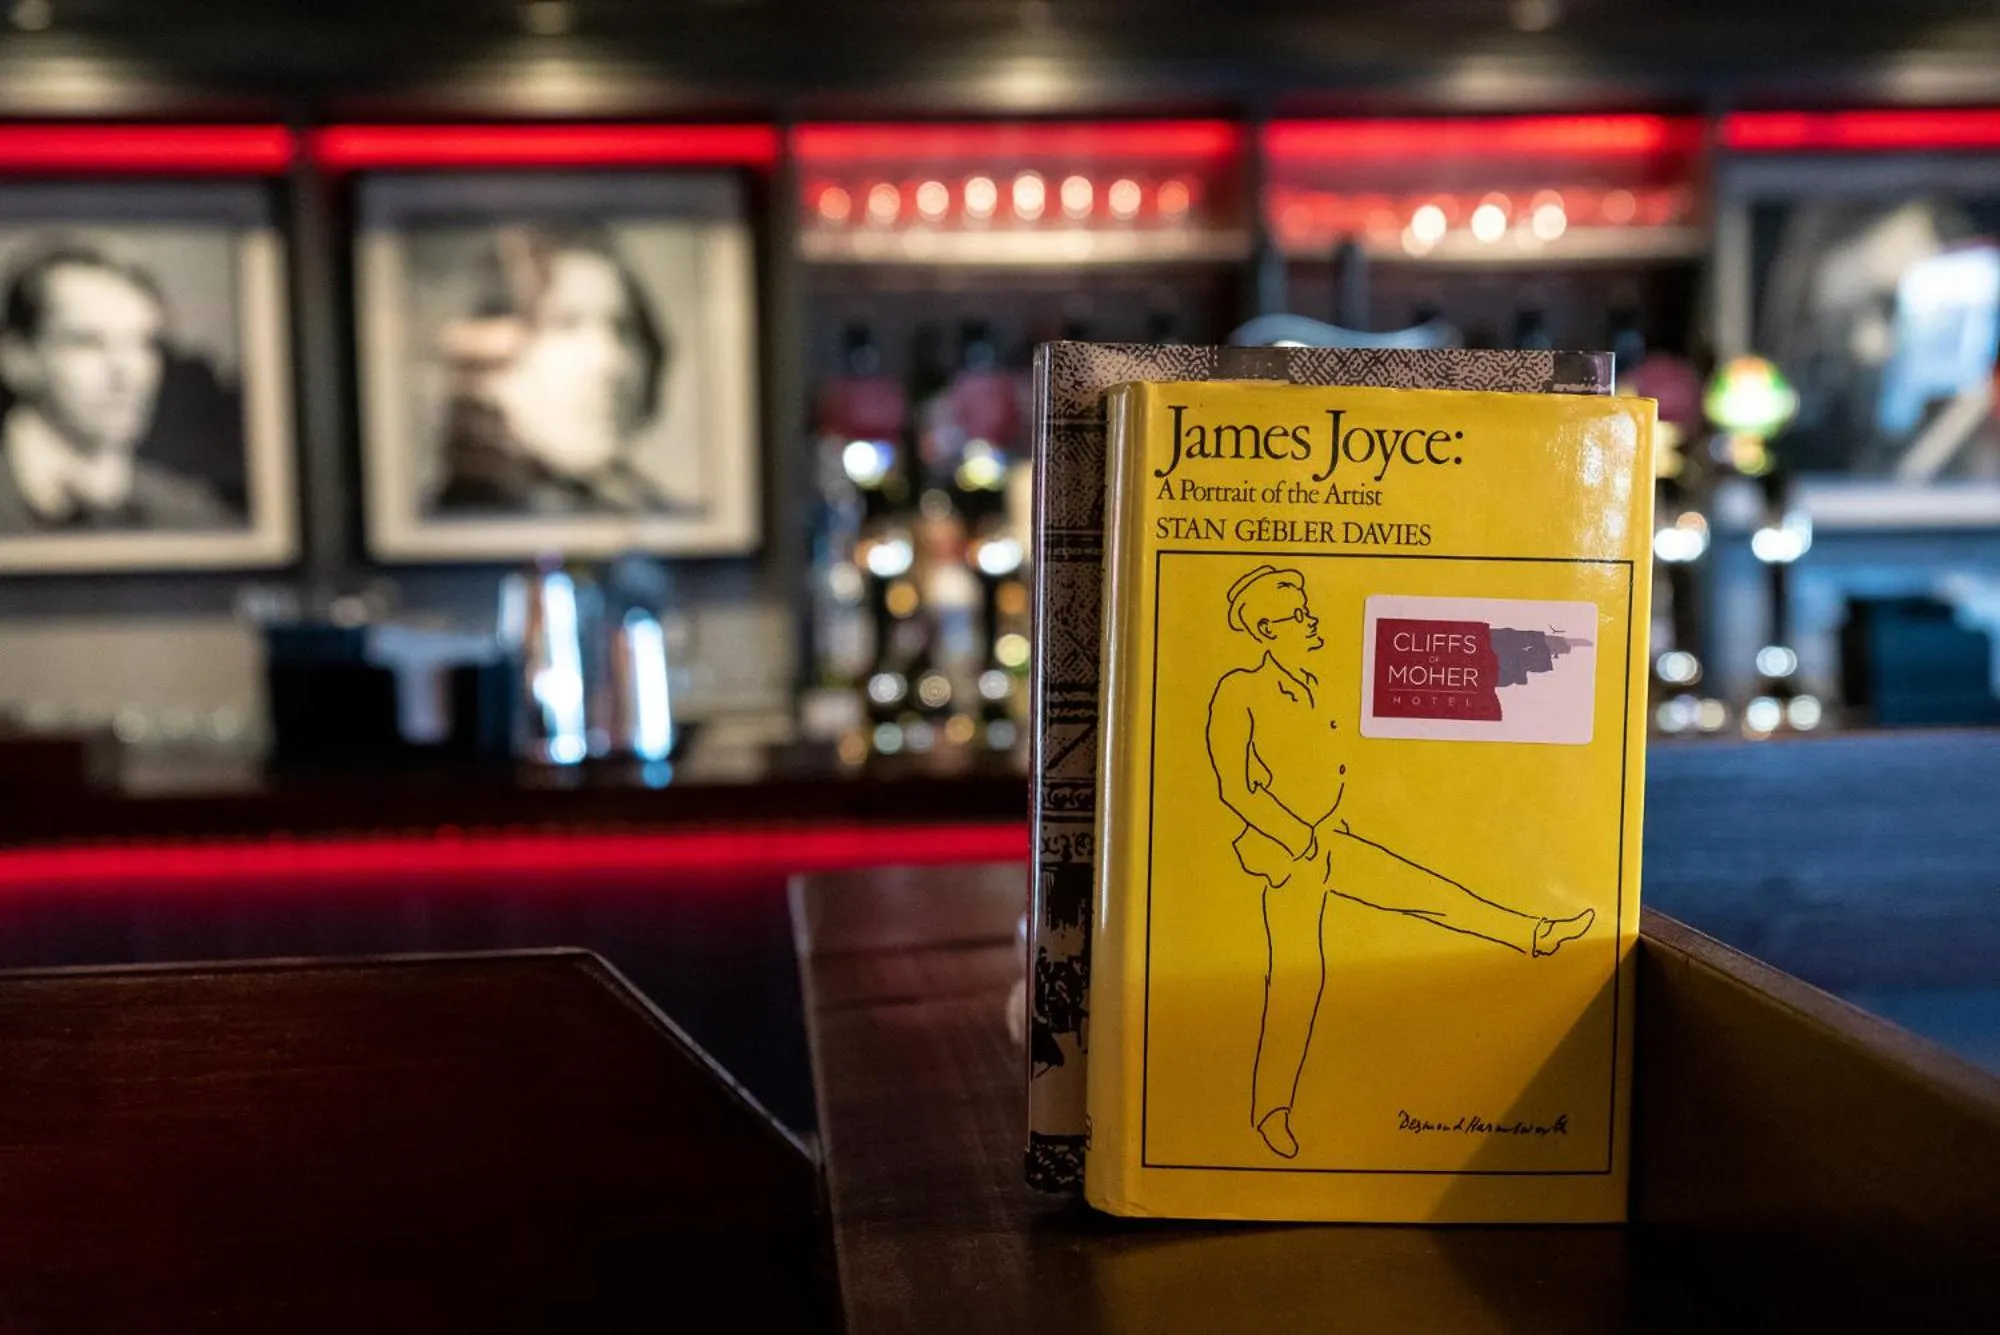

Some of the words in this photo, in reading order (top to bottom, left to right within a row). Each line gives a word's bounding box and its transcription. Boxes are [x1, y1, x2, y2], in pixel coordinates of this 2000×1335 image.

[1154, 405, 1311, 479] James
[1311, 409, 1464, 482] Joyce:
[1157, 478, 1175, 501] A
[1180, 479, 1257, 503] Portrait
[1261, 480, 1283, 503] of
[1287, 481, 1319, 504] the
[1325, 482, 1382, 505] Artist
[1156, 517, 1226, 541] STAN
[1234, 515, 1337, 543] GÉBLER
[1343, 521, 1432, 546] DAVIES
[1393, 632, 1477, 654] CLIFFS
[1388, 665, 1479, 687] MOHER
